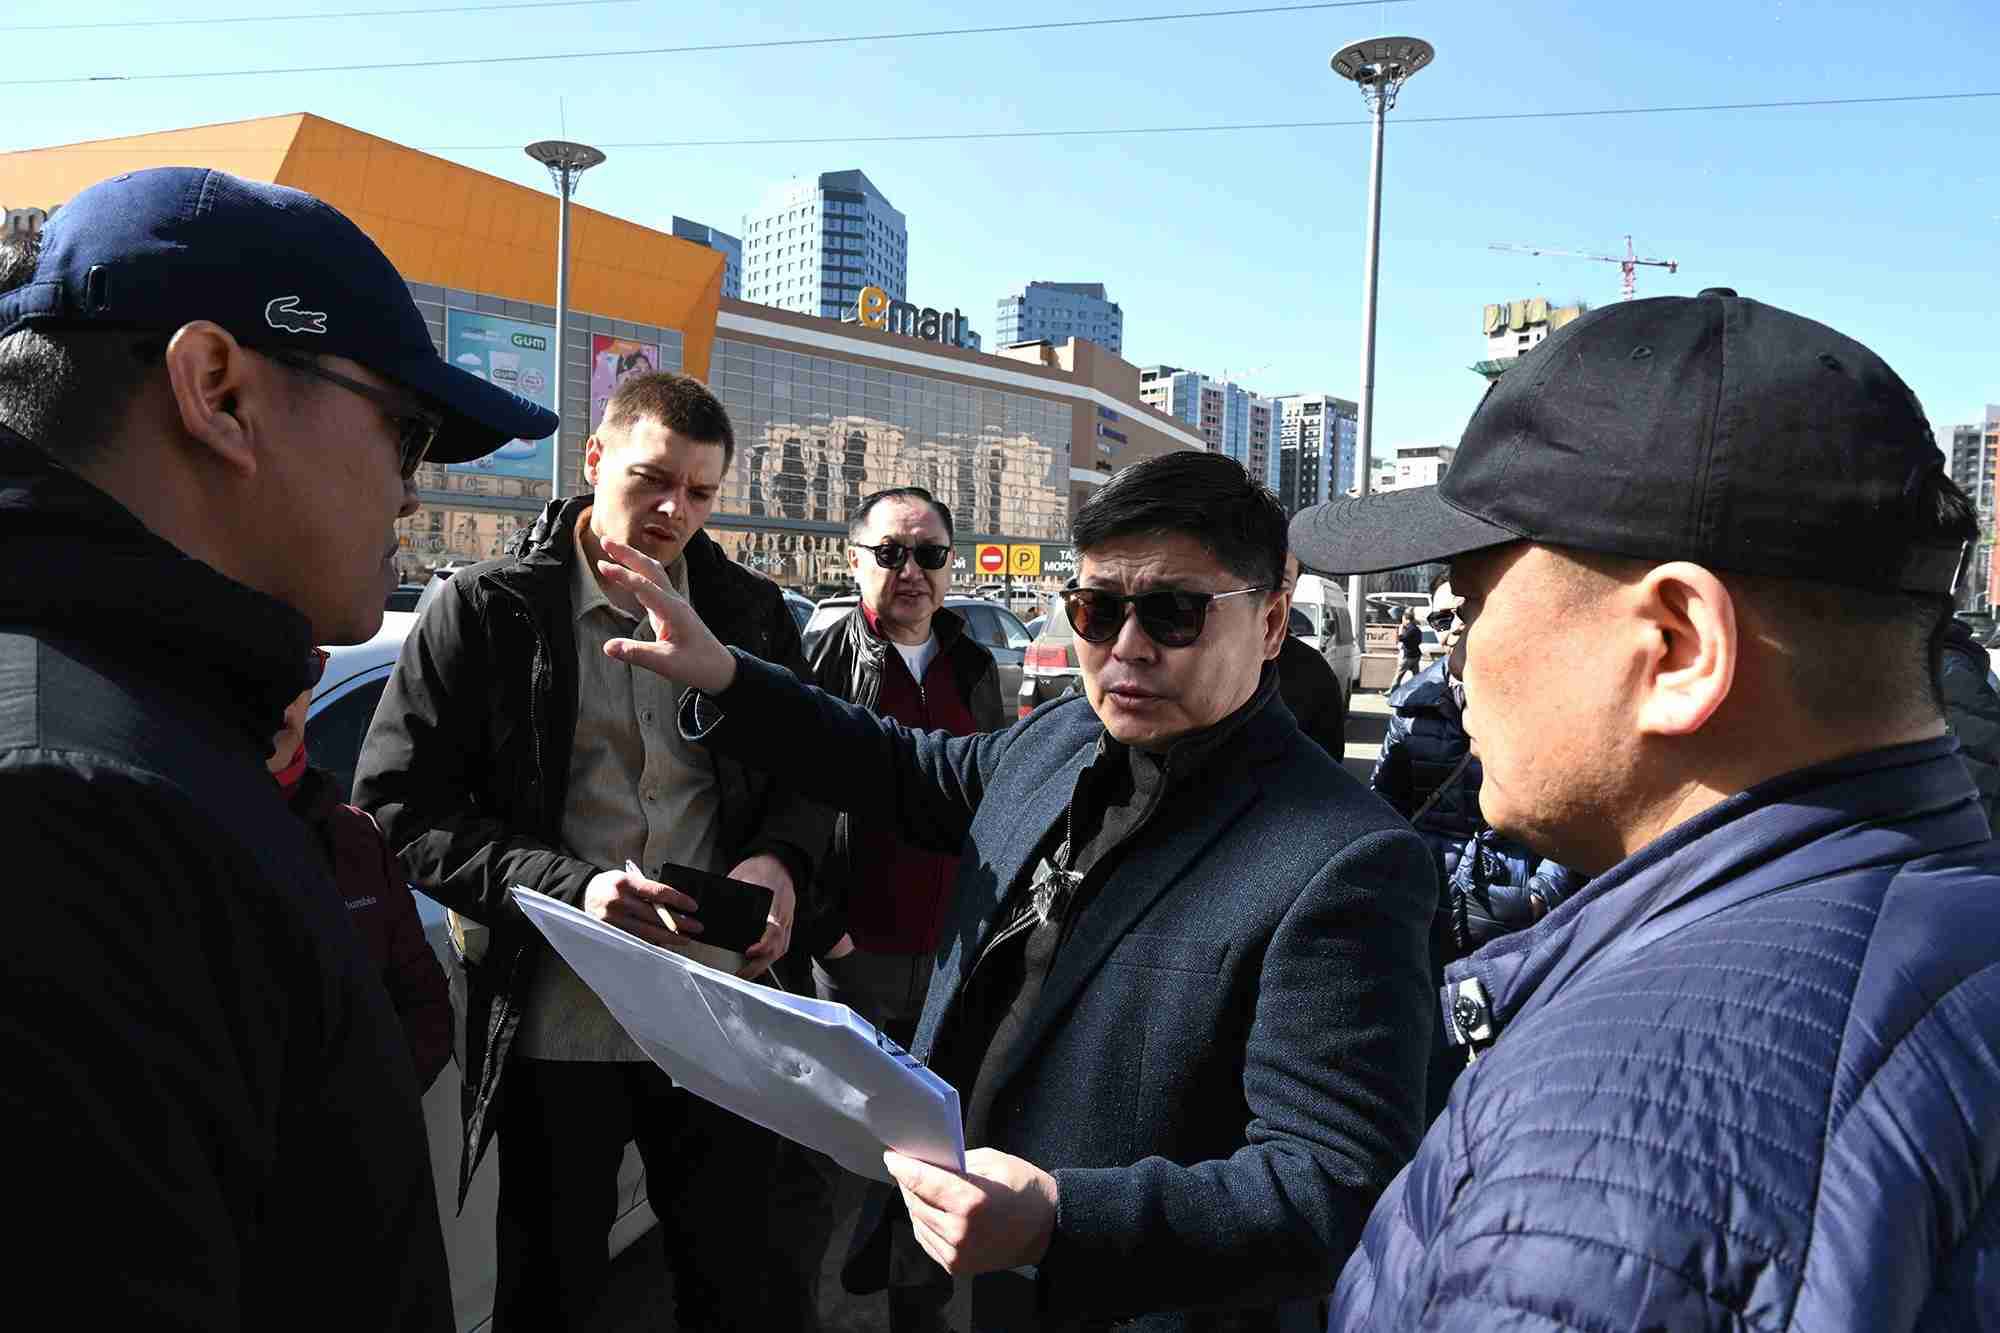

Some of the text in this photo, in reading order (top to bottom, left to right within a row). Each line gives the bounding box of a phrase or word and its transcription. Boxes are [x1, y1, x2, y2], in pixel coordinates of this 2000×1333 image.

[858, 286, 961, 346] emart
[512, 334, 546, 351] GUM
[1043, 561, 1075, 572] МОРИ
